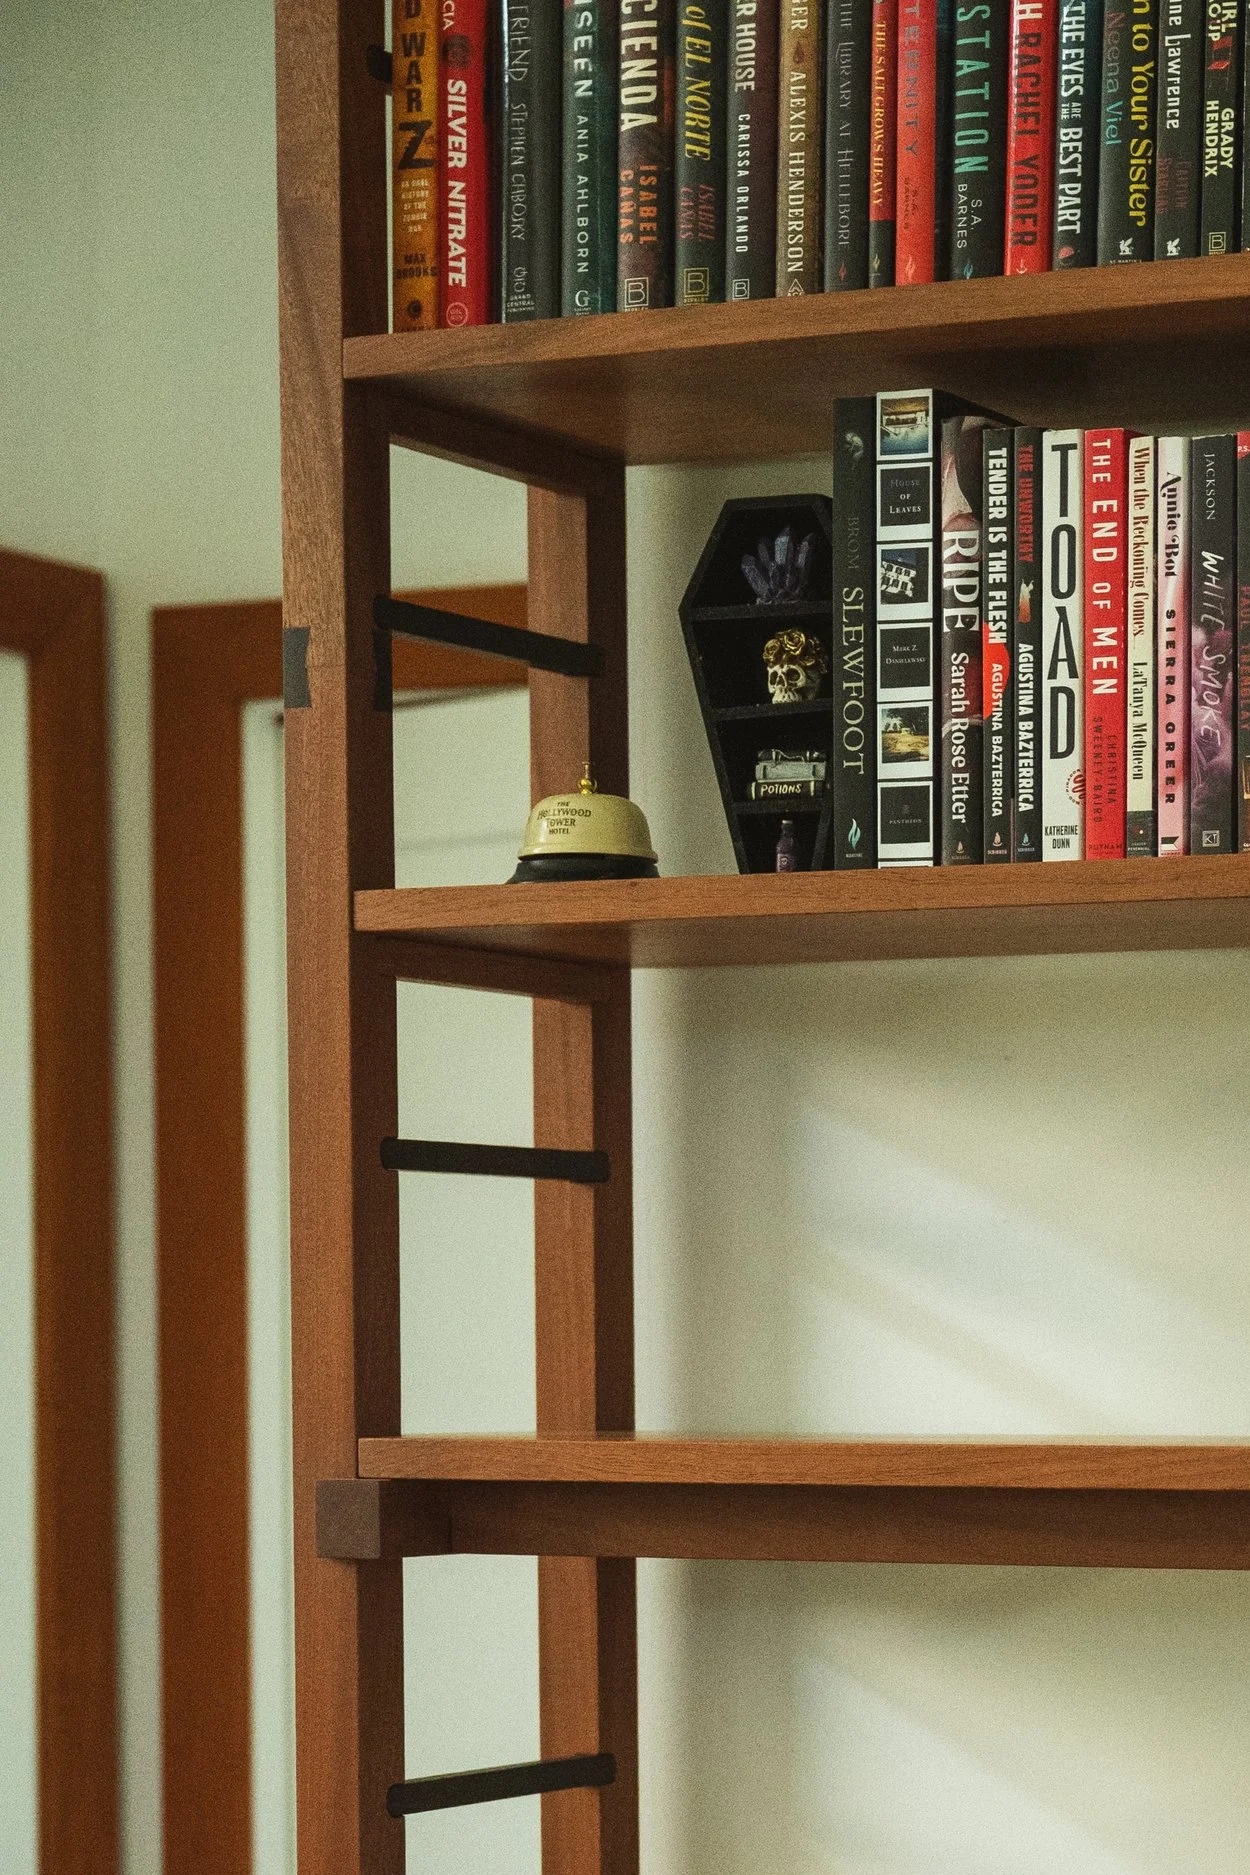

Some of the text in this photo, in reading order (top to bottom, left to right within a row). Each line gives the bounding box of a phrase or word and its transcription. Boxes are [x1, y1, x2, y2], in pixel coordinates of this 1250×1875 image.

[835, 42, 854, 109] LIBRARY
[954, 5, 990, 174] STATION
[1061, 5, 1085, 103] THE EYES
[838, 122, 851, 138] AT
[1012, 32, 1042, 247] RACHEL YODER
[1061, 103, 1070, 120] THE
[1071, 102, 1081, 119] ARE
[1128, 23, 1155, 228] to Your Sister
[1204, 100, 1219, 177] HENDRIX
[1220, 107, 1234, 169] GRADY
[447, 78, 467, 288] SILVER NITRATE
[511, 103, 527, 241] STEPHEN CHBOSKY
[577, 115, 589, 273] ANIA AHLBORN
[736, 114, 750, 253] CARISSA ORLANDO
[787, 71, 806, 272] ALEXIS HENDERSON
[837, 150, 853, 248] HELLEBORE
[957, 184, 968, 248] BARNES
[971, 199, 982, 230] S.A.
[1058, 127, 1083, 234] BEST PART
[889, 504, 922, 514] LEAVES
[988, 447, 1008, 644] TENDER IS THE FLESH
[1130, 447, 1150, 638] When the Reckoning Comes
[943, 530, 980, 633] RIPE
[1047, 443, 1079, 760] TOAD
[1092, 439, 1118, 695] THE END OF MEN
[842, 587, 865, 775] SLEWFOOT
[761, 782, 802, 796] POTIONS
[950, 652, 970, 824] Sarah Rose Etter
[991, 663, 1003, 817] AGUSTINA BAZTERRICA
[537, 808, 592, 820] HOLLYWOOD
[546, 818, 576, 828] TOWER
[1044, 825, 1079, 836] KATHERINE
[1052, 838, 1071, 849] DUNN
